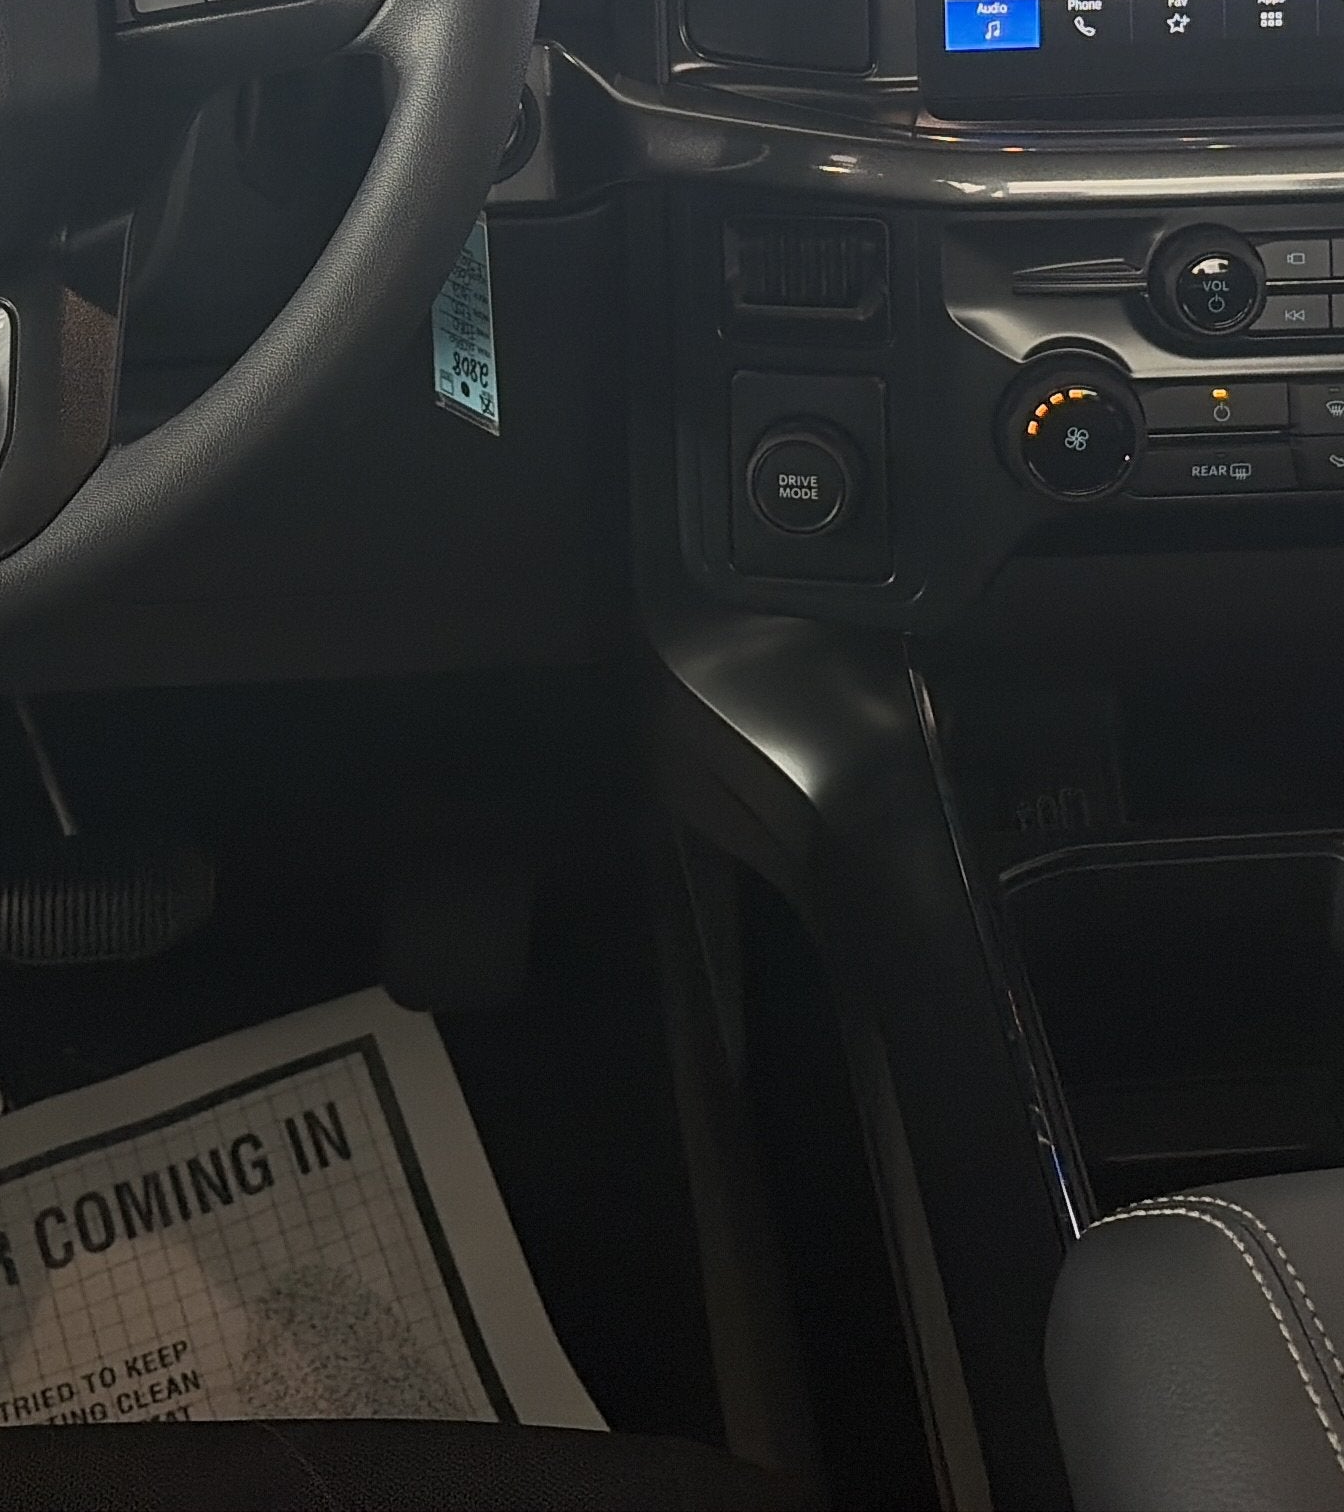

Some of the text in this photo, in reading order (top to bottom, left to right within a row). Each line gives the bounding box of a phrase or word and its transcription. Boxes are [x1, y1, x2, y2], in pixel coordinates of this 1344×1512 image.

[976, 1, 1008, 15] Audio
[1202, 280, 1230, 292] VOL
[1191, 464, 1227, 477] REAR
[778, 474, 819, 487] DRIVE
[778, 487, 819, 500] MODE
[33, 1132, 275, 1271] COMING
[284, 1100, 353, 1175] IN
[81, 1366, 117, 1395] TO
[124, 1339, 189, 1380] KEEP
[116, 1369, 202, 1415] CLEAN
